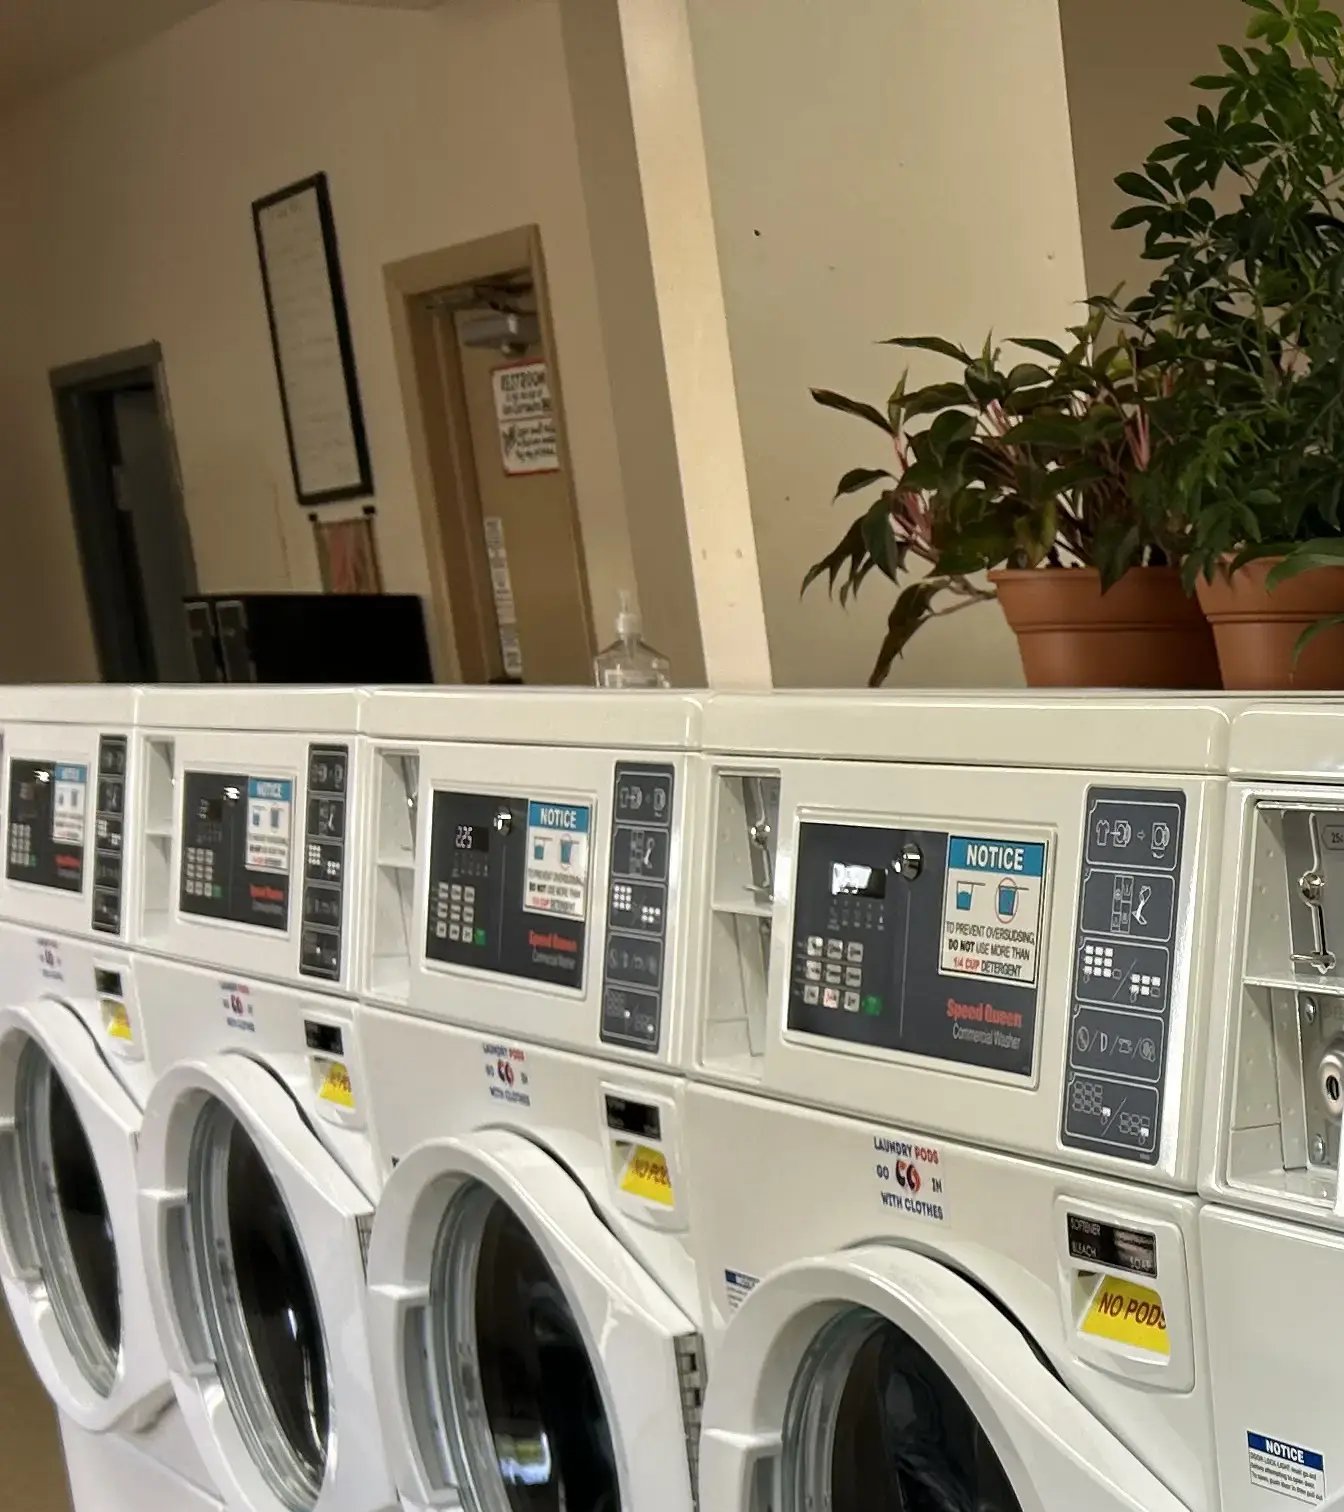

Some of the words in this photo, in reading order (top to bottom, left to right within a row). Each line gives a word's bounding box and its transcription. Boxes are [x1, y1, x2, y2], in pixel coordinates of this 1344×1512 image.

[540, 807, 576, 829] NOTICE
[966, 843, 1024, 870] NOTICE
[948, 938, 959, 951] DO
[960, 941, 975, 953] NOT
[976, 942, 990, 956] USE
[990, 944, 1011, 959] MORE
[1011, 946, 1030, 961] THAN
[873, 1136, 912, 1158] LAUNDRY
[914, 1145, 939, 1165] PODS
[880, 1191, 903, 1209] WITH
[904, 1198, 943, 1220] CLOTHES
[1098, 1291, 1124, 1318] NO
[1265, 1439, 1305, 1464] NOTICE
